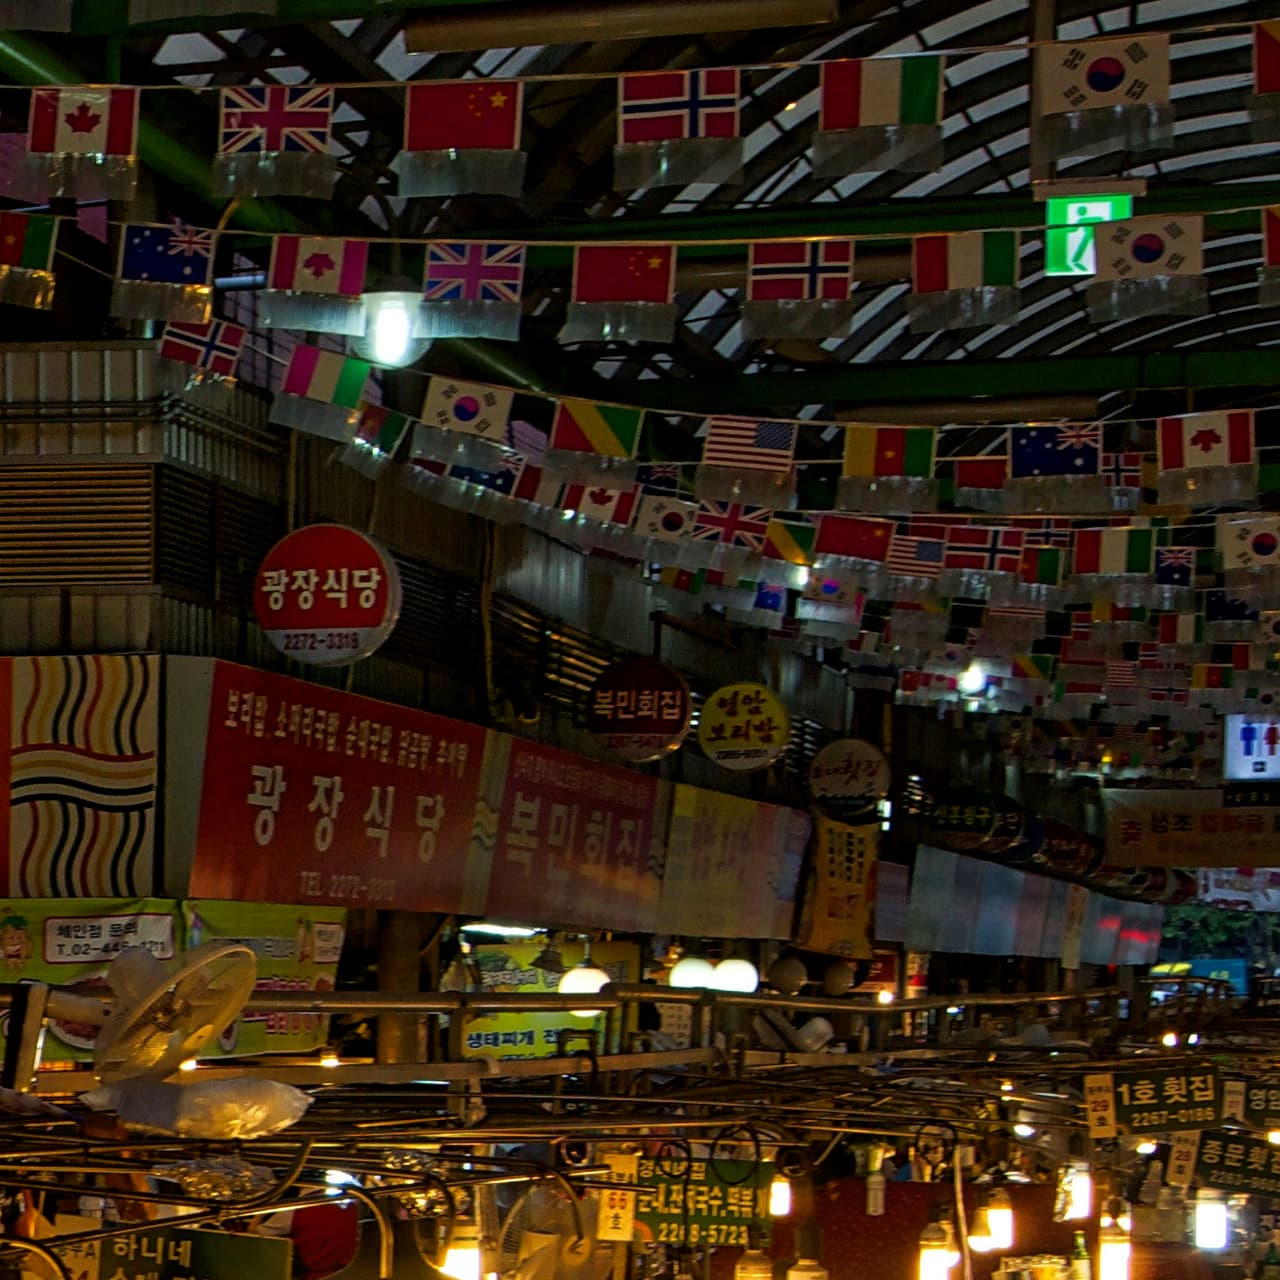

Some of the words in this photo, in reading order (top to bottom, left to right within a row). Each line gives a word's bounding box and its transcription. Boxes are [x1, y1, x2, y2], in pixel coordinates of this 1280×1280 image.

[261, 568, 382, 611] 광장식당
[706, 717, 779, 743] 보리밥
[245, 764, 446, 864] 광장식당
[112, 1234, 193, 1268] 하니네
